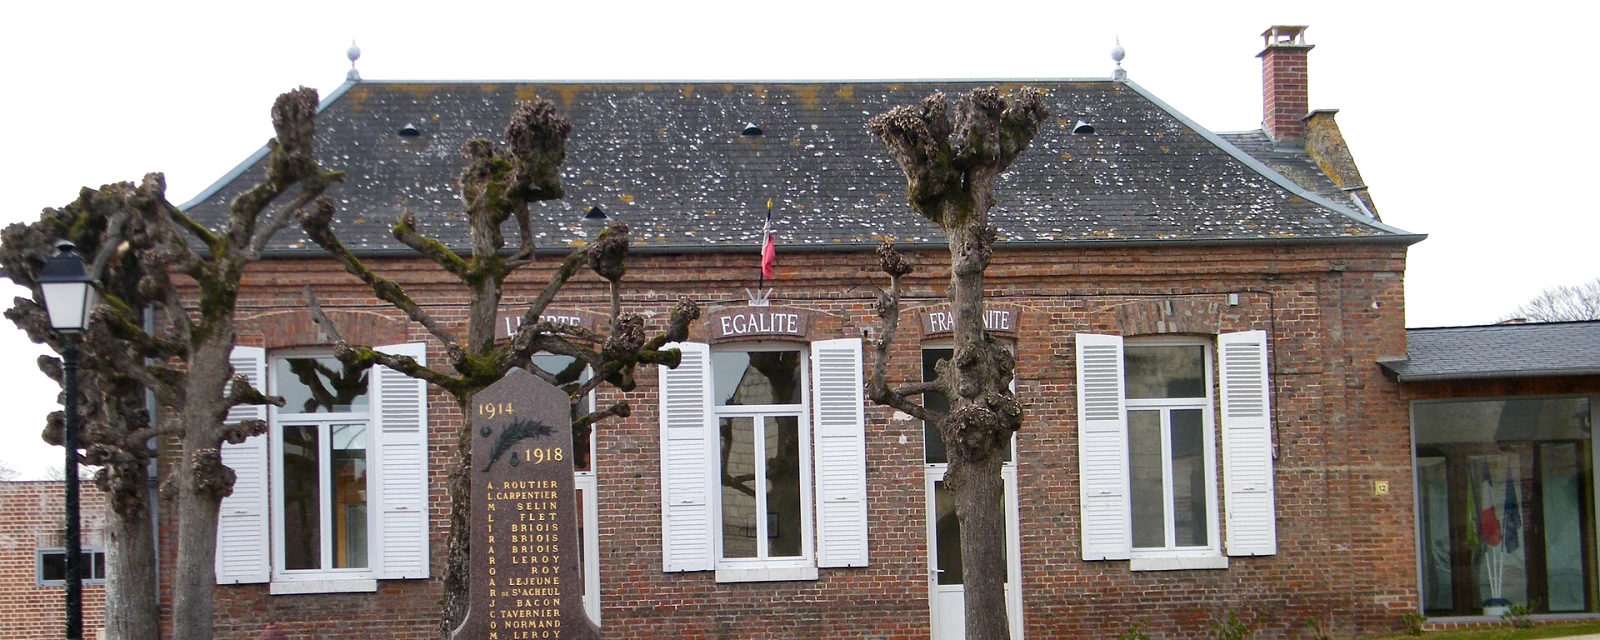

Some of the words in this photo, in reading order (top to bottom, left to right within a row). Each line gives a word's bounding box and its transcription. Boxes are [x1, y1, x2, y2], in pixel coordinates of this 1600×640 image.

[720, 313, 804, 336] EGALITE
[929, 310, 1010, 332] FRANITE
[478, 403, 514, 420] 1914
[525, 448, 563, 464] 1918
[504, 481, 558, 489] ROUTIER
[517, 502, 557, 511] SELIN
[520, 513, 557, 521] FLET
[512, 524, 558, 532] BRIOIS
[512, 535, 558, 543] BRIOIS
[512, 545, 559, 553] BRIOIS
[513, 556, 559, 564] LEROY
[509, 577, 560, 586] LEJEUNE
[517, 599, 560, 607] BACON
[500, 609, 560, 618] TAVERNIER
[505, 620, 561, 629] NORMAND
[514, 631, 560, 639] LEROY
